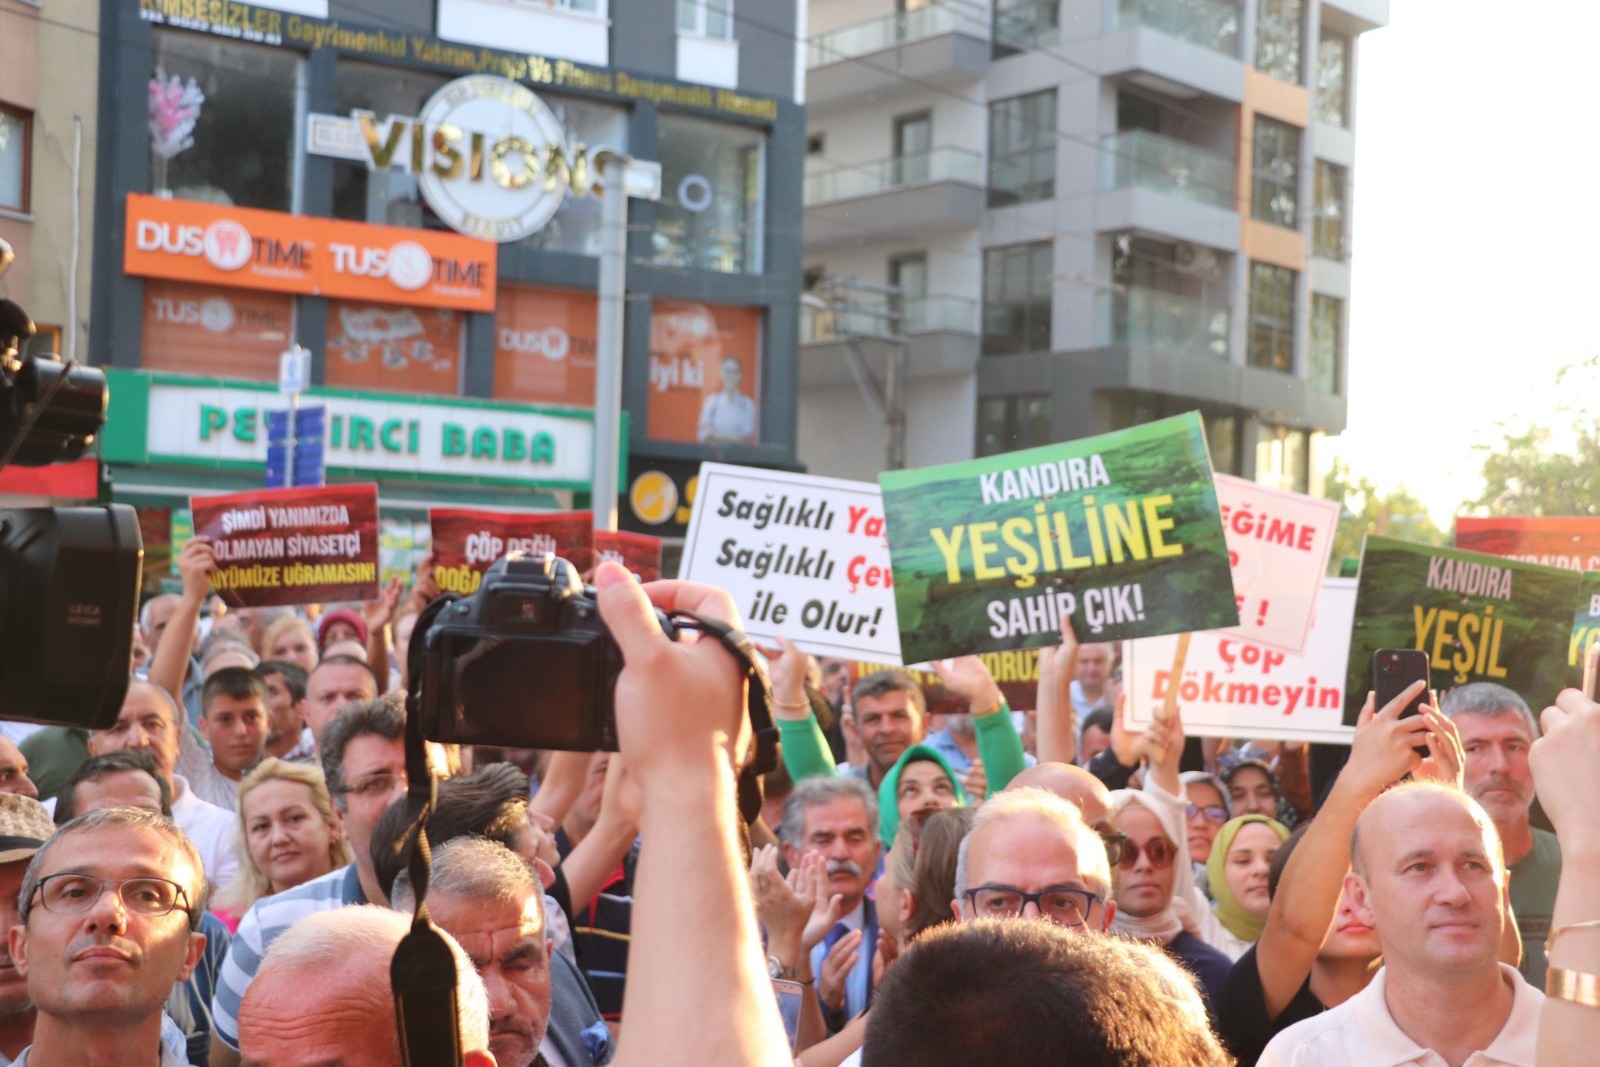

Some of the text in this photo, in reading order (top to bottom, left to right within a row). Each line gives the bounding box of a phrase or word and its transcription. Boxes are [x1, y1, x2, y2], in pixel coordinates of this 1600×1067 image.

[136, 219, 312, 271] DUS TIME
[328, 242, 390, 279] TUS
[431, 255, 488, 289] TIME
[153, 297, 201, 325] TUS
[499, 327, 542, 353] DUS
[442, 421, 556, 466] BABA
[980, 453, 1111, 505] KANDIRA
[222, 504, 350, 535] ŞİMDİ YANIMIZDA
[717, 489, 835, 531] Sağlıklı
[214, 529, 361, 562] OLMAYAN SİYASETÇİ
[465, 531, 503, 565] ÇÖP
[716, 537, 835, 580] Sağlıklı
[929, 494, 1184, 589] YEŞİLİNE
[283, 560, 376, 588] UĞRAMASIN!
[435, 565, 482, 596] DOĞA
[1426, 556, 1513, 601] KANDIRA
[749, 590, 883, 638] ile Olur!
[986, 583, 1146, 639] SAHİP ÇIK!
[1413, 604, 1508, 685] YEŞİL
[1152, 670, 1341, 716] Dökmeyin
